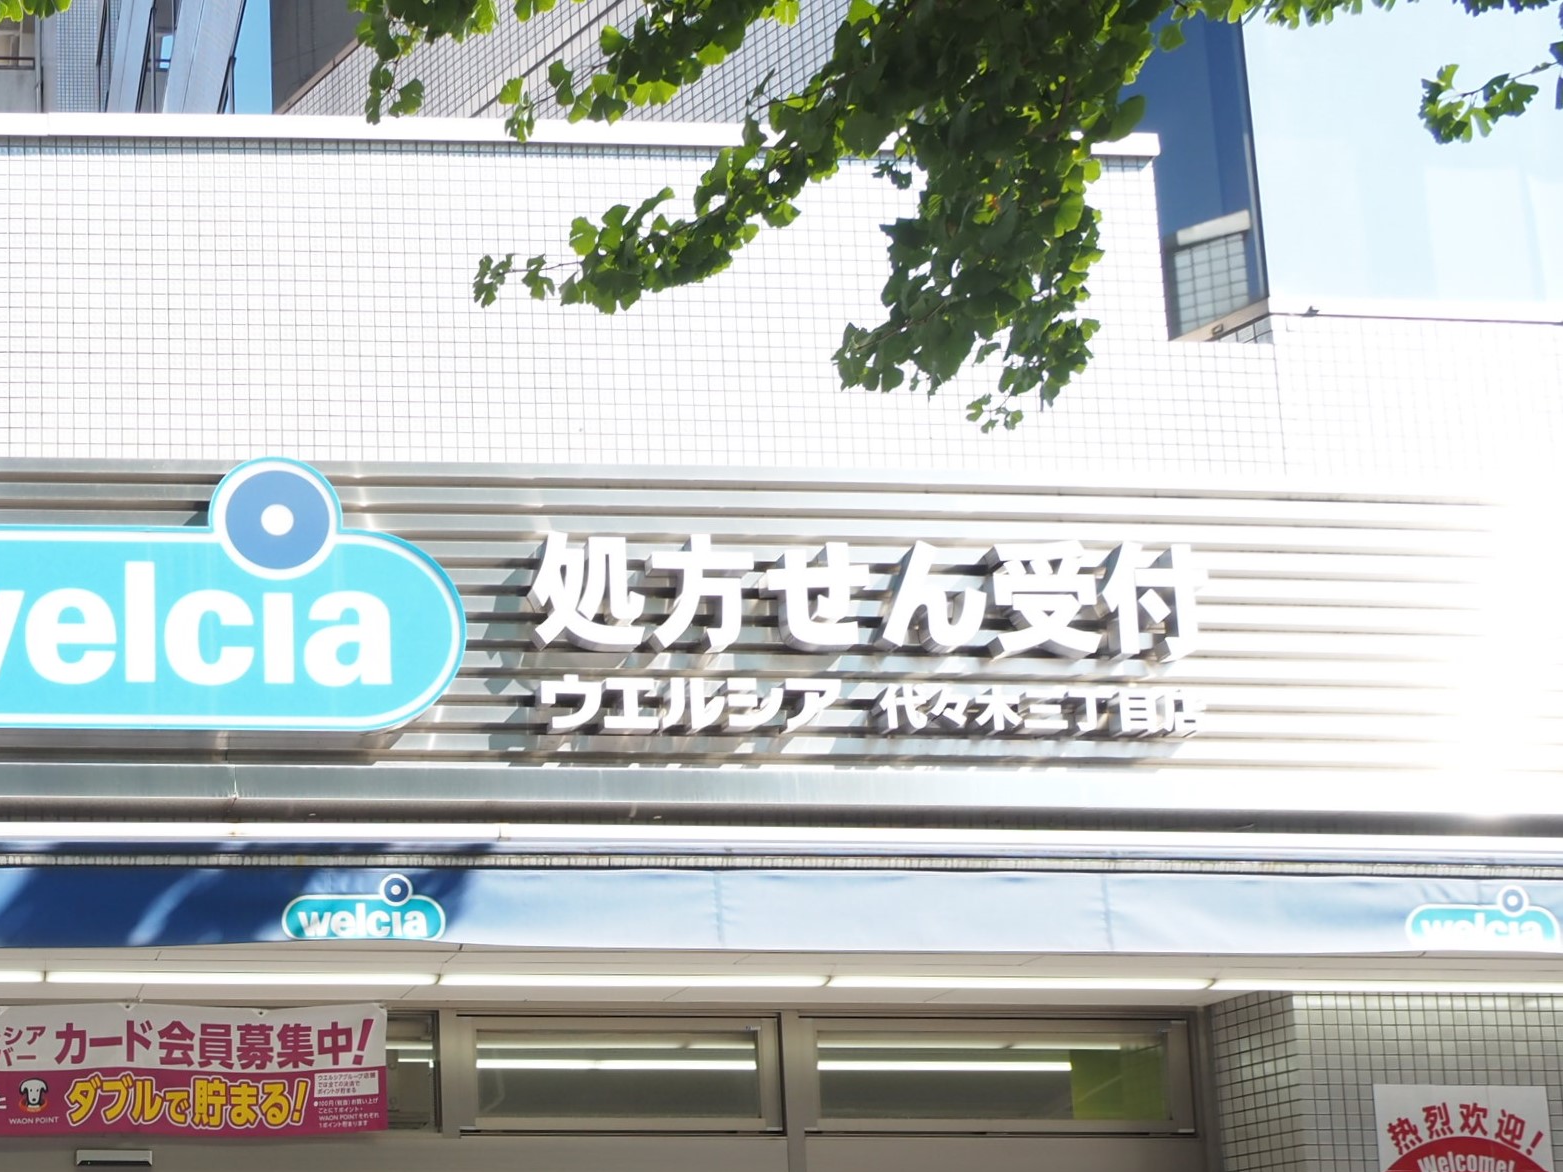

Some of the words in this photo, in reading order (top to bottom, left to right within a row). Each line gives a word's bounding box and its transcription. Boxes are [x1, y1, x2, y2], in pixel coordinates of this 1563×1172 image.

[528, 531, 1207, 660] 処方せん受付
[540, 675, 843, 733] ウエルシア
[880, 685, 1207, 735] 代々木三丁目店
[295, 893, 428, 938] welcia
[54, 1018, 374, 1071] カード会員募集中!
[9, 1117, 34, 1125] WAON
[35, 1116, 60, 1124] POINT
[66, 1074, 309, 1128] ダブルで貯まる!
